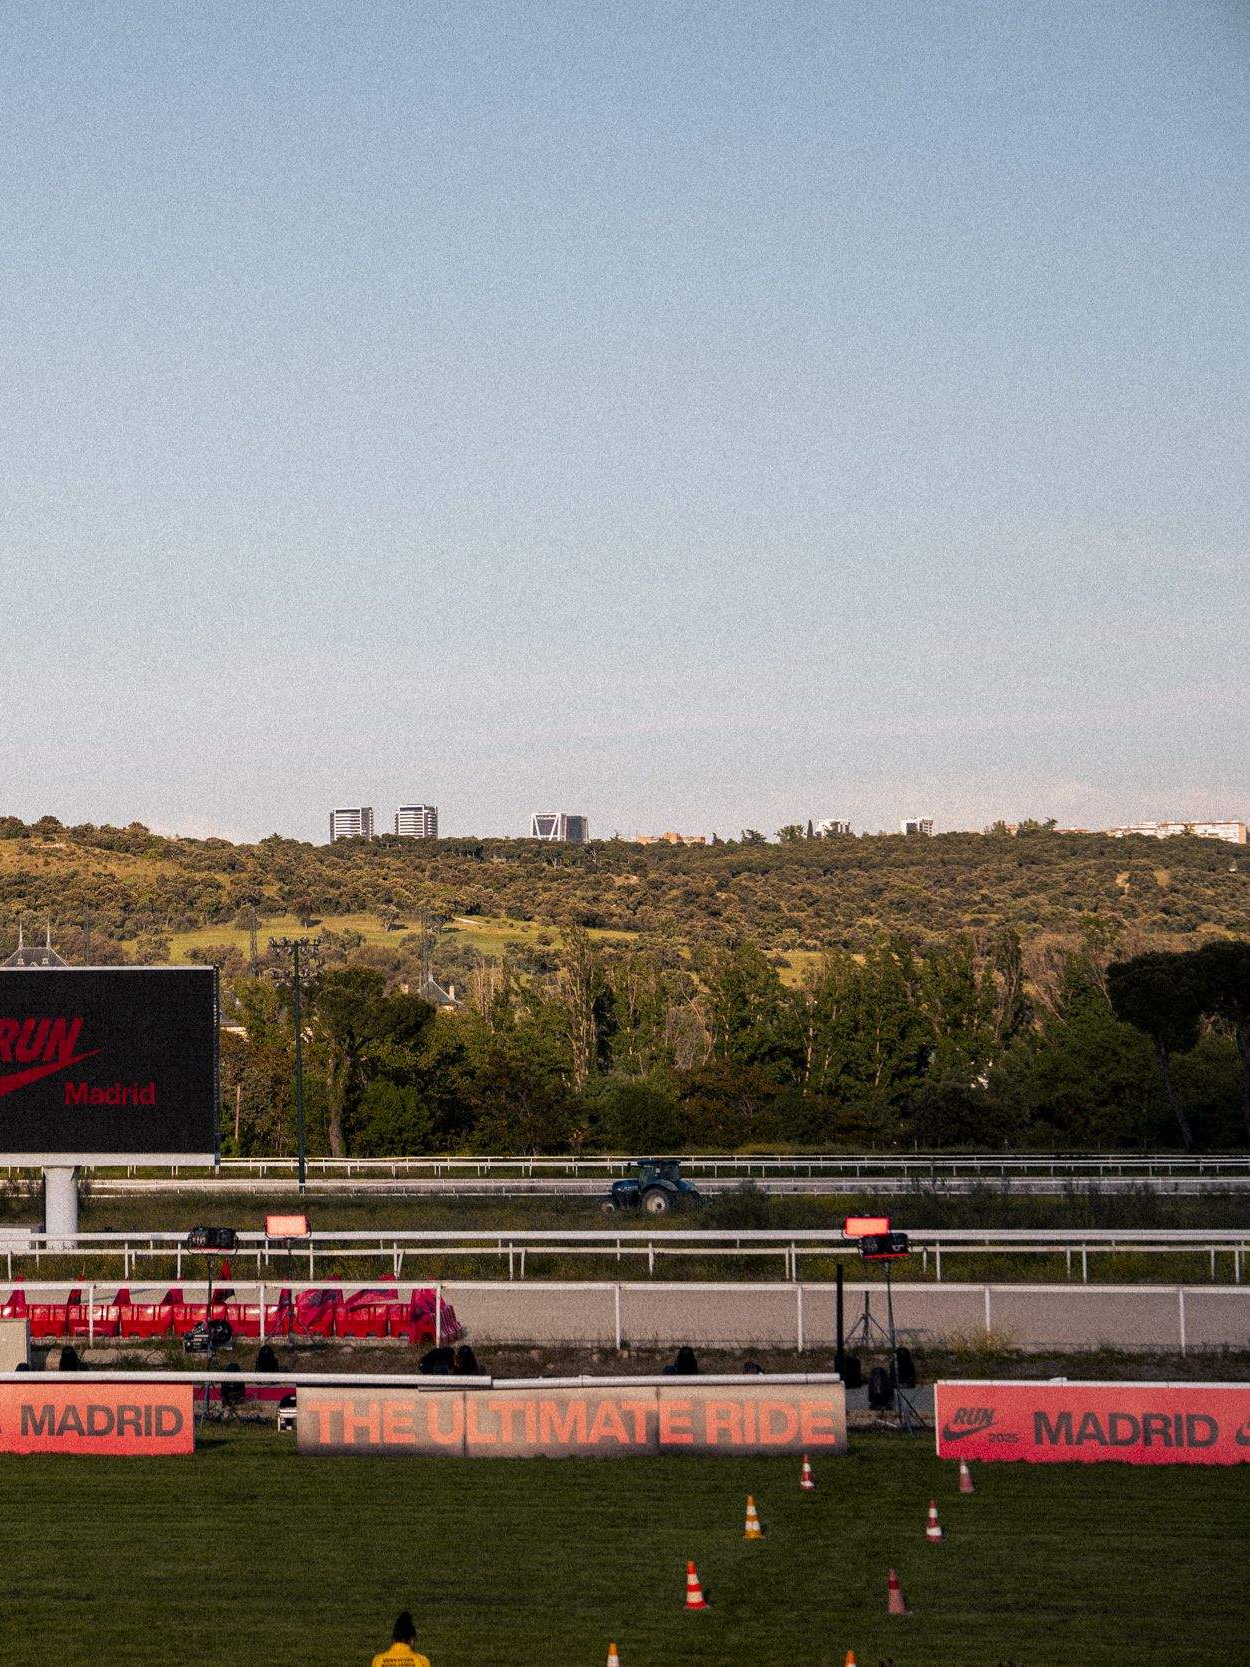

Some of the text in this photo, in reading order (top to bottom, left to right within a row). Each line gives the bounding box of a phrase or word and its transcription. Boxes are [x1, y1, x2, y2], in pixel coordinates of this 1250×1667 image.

[64, 1080, 156, 1105] Madrid
[20, 1404, 184, 1437] MADRID
[306, 1399, 836, 1444] THE ULTIMATE RIDE
[953, 1407, 995, 1426] RUN
[1033, 1411, 1220, 1447] MADRID
